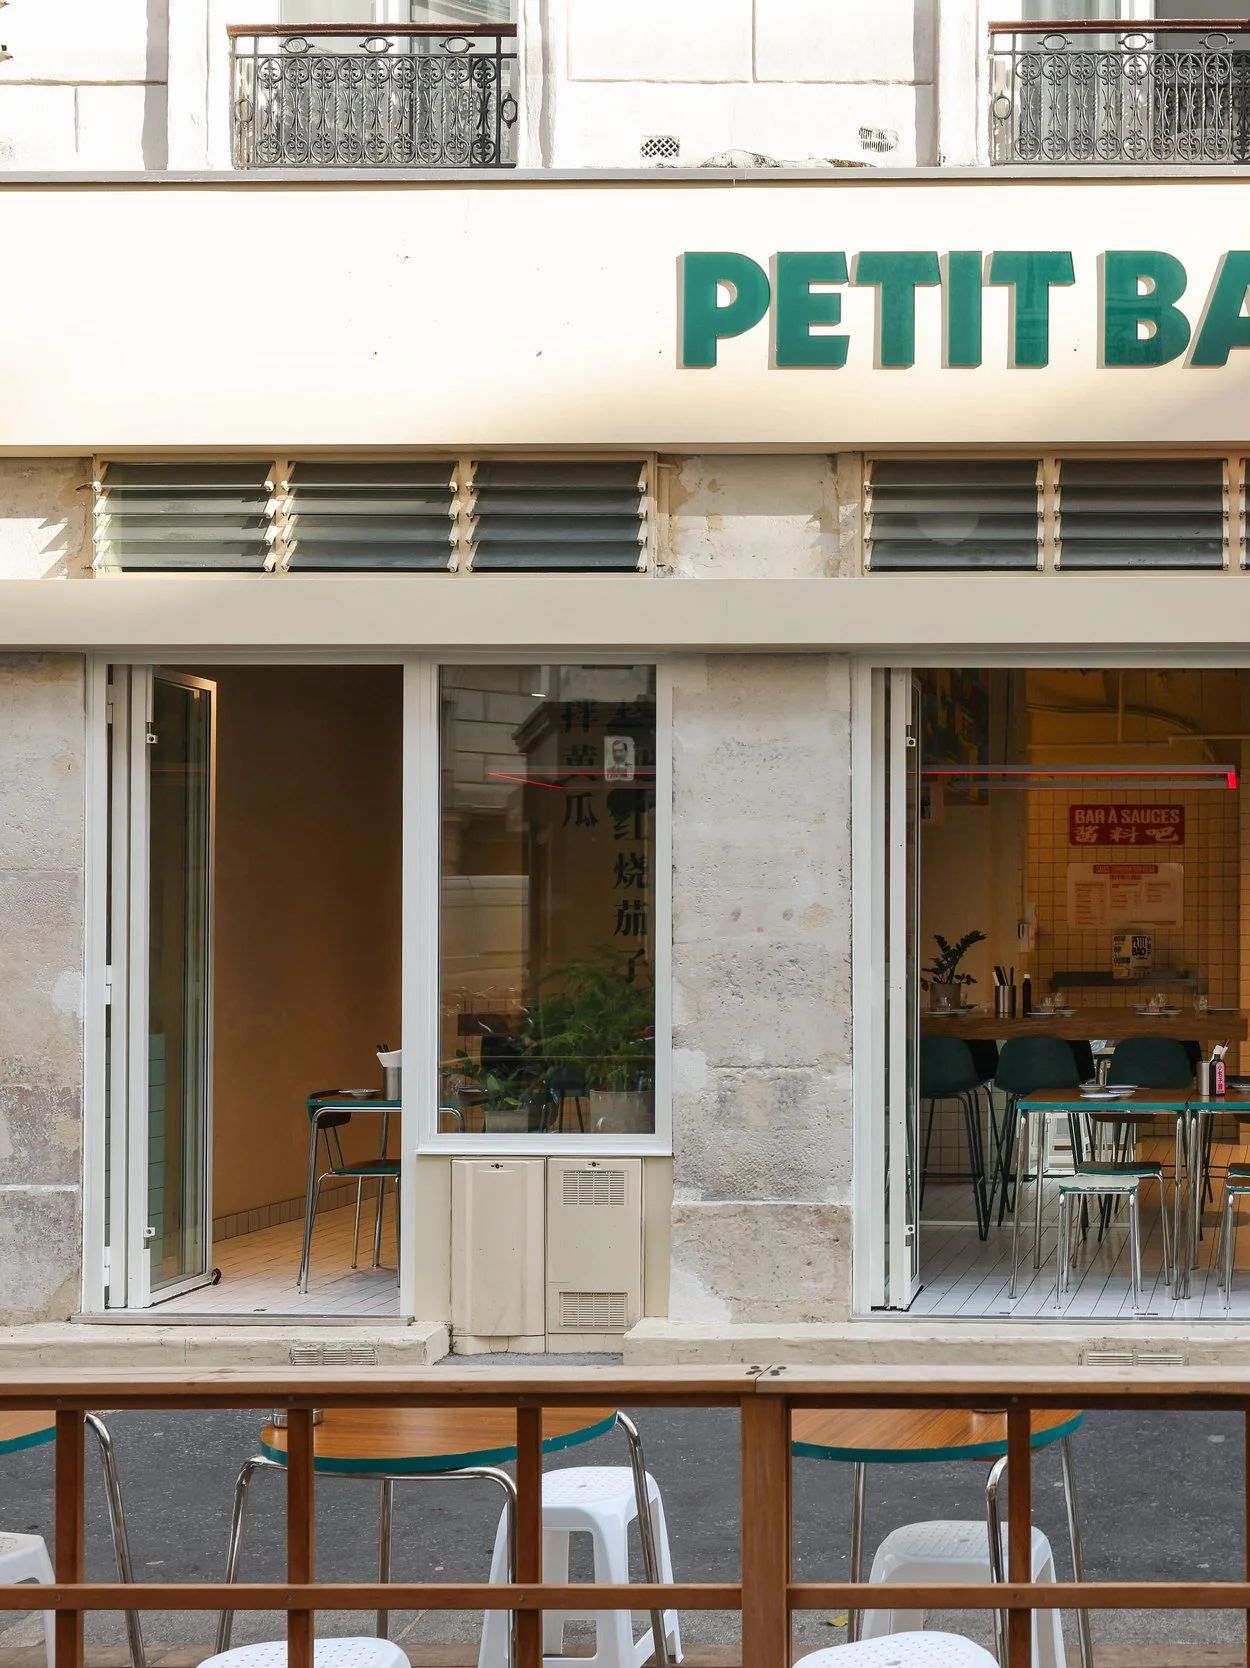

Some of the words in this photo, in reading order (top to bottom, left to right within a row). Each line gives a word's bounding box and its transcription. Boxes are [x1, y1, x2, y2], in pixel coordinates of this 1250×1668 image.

[677, 250, 1076, 369] PETIT
[1075, 809, 1105, 824] BAR
[1108, 806, 1119, 824] À
[1121, 808, 1181, 824] SAUCES
